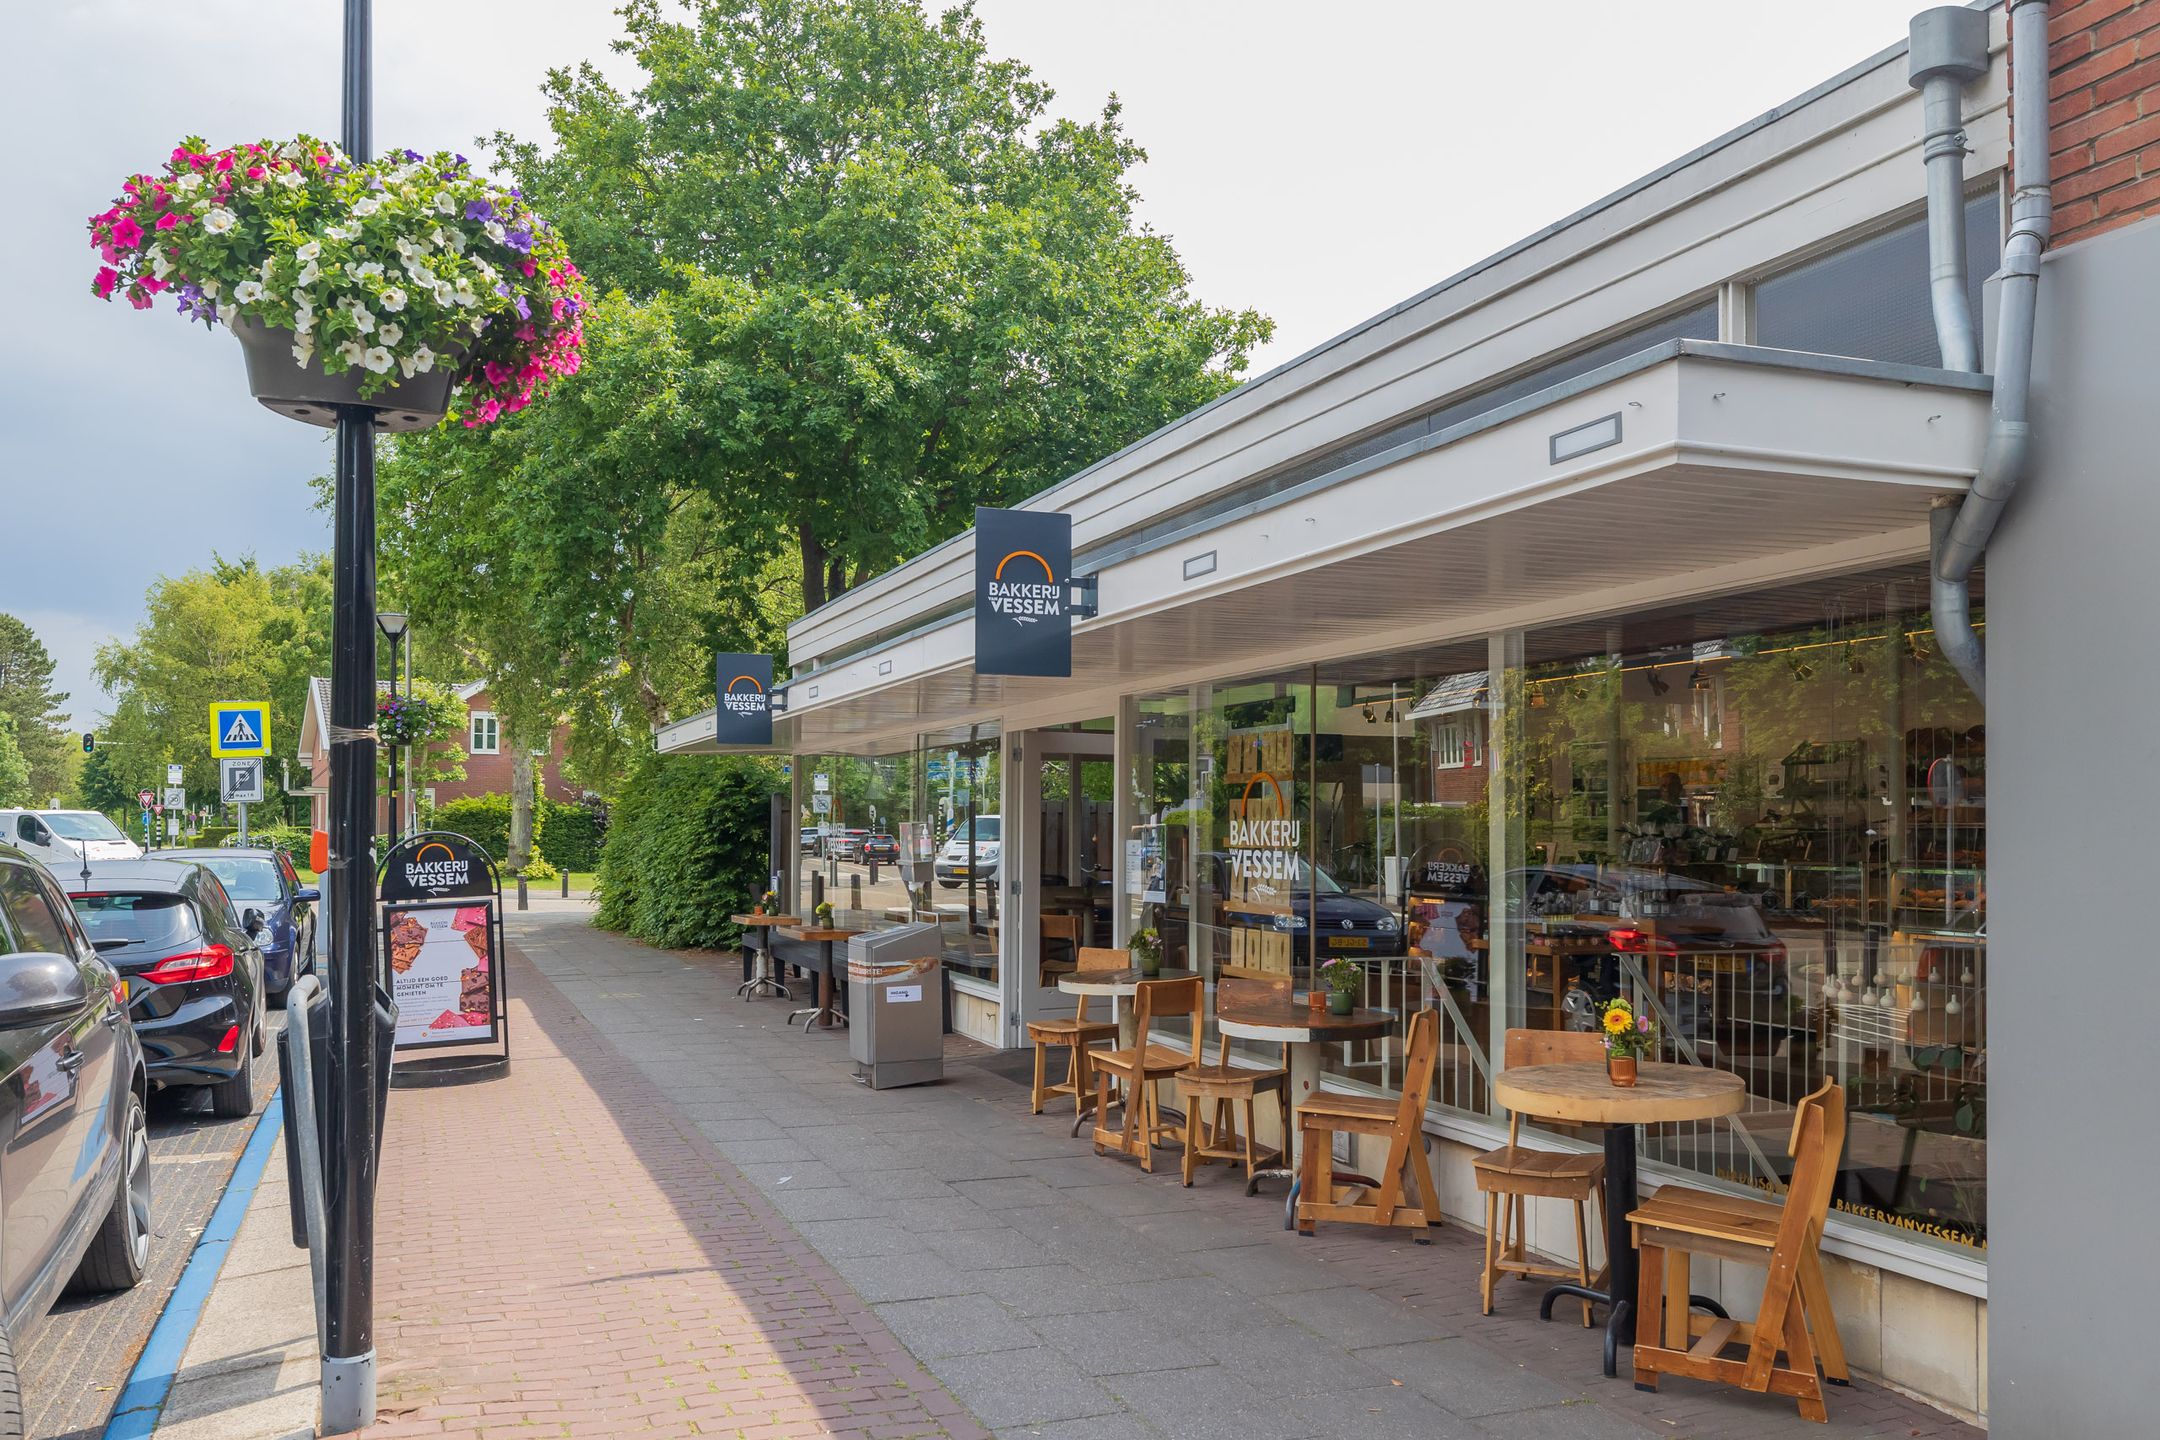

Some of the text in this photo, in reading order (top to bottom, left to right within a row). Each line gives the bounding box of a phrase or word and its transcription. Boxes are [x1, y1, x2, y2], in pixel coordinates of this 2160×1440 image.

[989, 582, 1060, 600] BAKKERIJ
[991, 597, 1060, 616] VESSEM
[724, 693, 766, 702] BAKKERIJ
[725, 701, 766, 711] VESSEM
[1230, 820, 1300, 847] BAKKERIJ
[405, 860, 469, 875] BAKKERIJ
[1231, 849, 1300, 881] VESSEM
[408, 872, 469, 887] VESSEM
